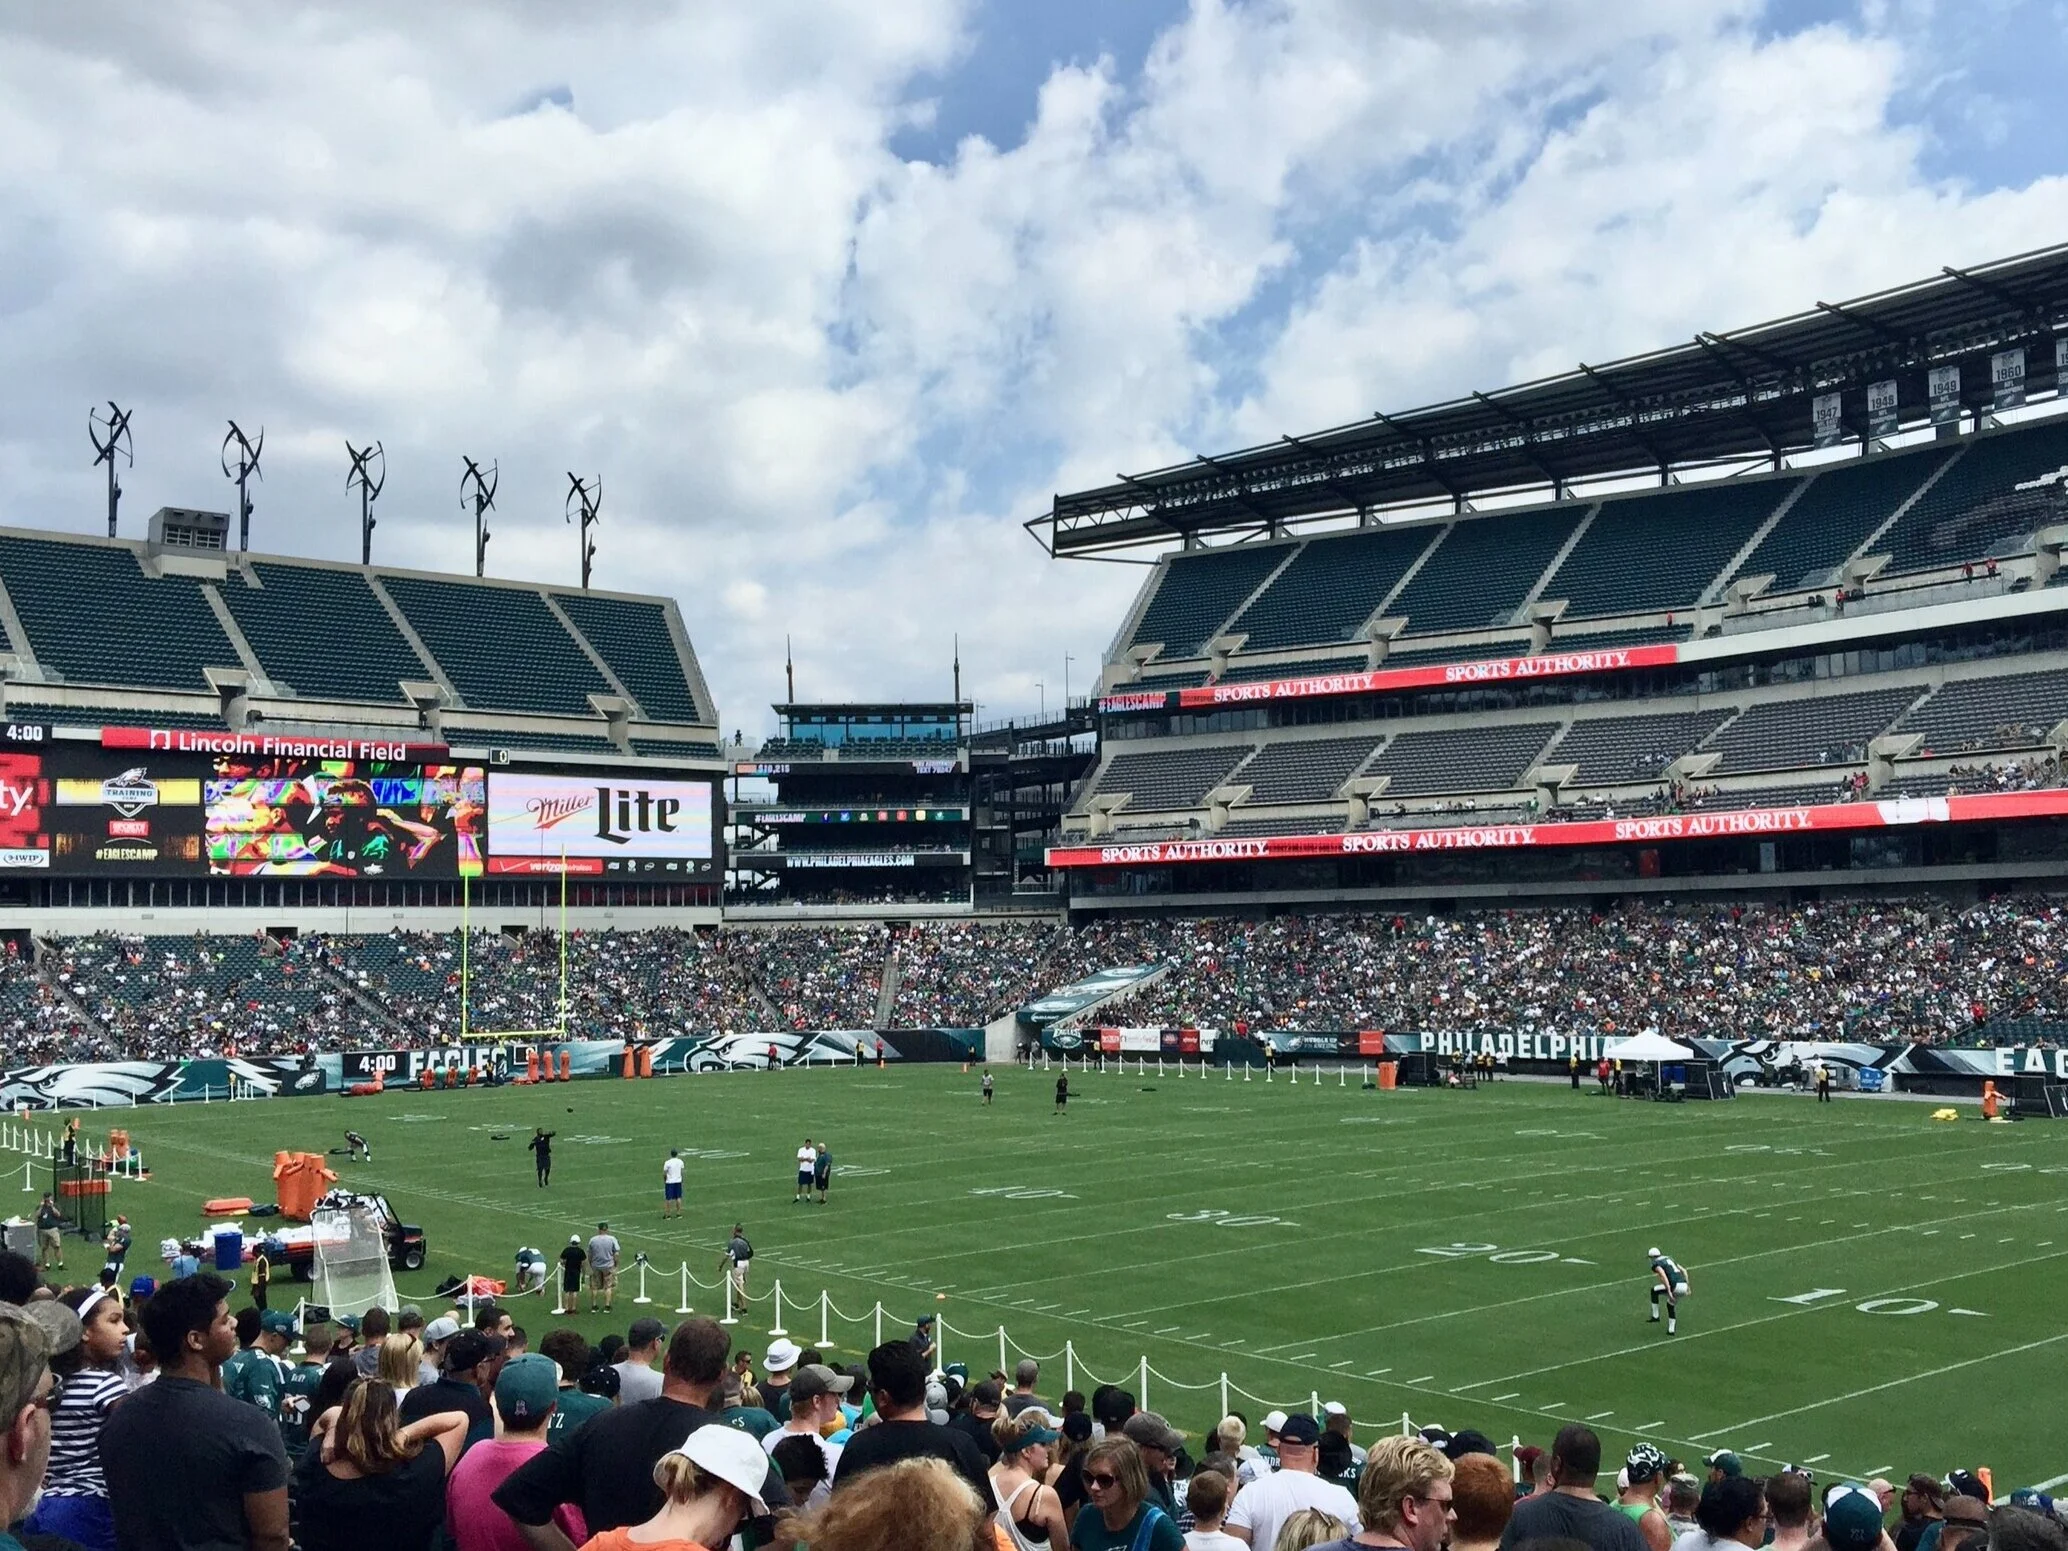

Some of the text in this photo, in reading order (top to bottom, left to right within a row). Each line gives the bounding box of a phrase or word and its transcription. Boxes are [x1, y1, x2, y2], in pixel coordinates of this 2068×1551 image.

[1933, 381, 1957, 395] 1949
[1816, 407, 1838, 420] 1947
[1445, 663, 1510, 682] SPORTS
[1214, 686, 1271, 702] SPORTS
[6, 725, 43, 741] 4:00
[179, 732, 406, 761] Lincoln Financial Field
[106, 789, 153, 797] TRAINING
[526, 787, 681, 844] Miller Lite
[1616, 818, 1683, 840] SPORTS
[1342, 833, 1410, 852] SPORTS
[95, 848, 158, 861] #EAGLESCAMP
[786, 855, 915, 867] WWW.PHILADELPHIAEAGLES.COM
[1101, 845, 1160, 863] SPORTS
[359, 1054, 397, 1072] 4:00
[1166, 1208, 1280, 1227] 30
[1414, 1242, 1560, 1264] 20
[1766, 1287, 1939, 1316] 10
